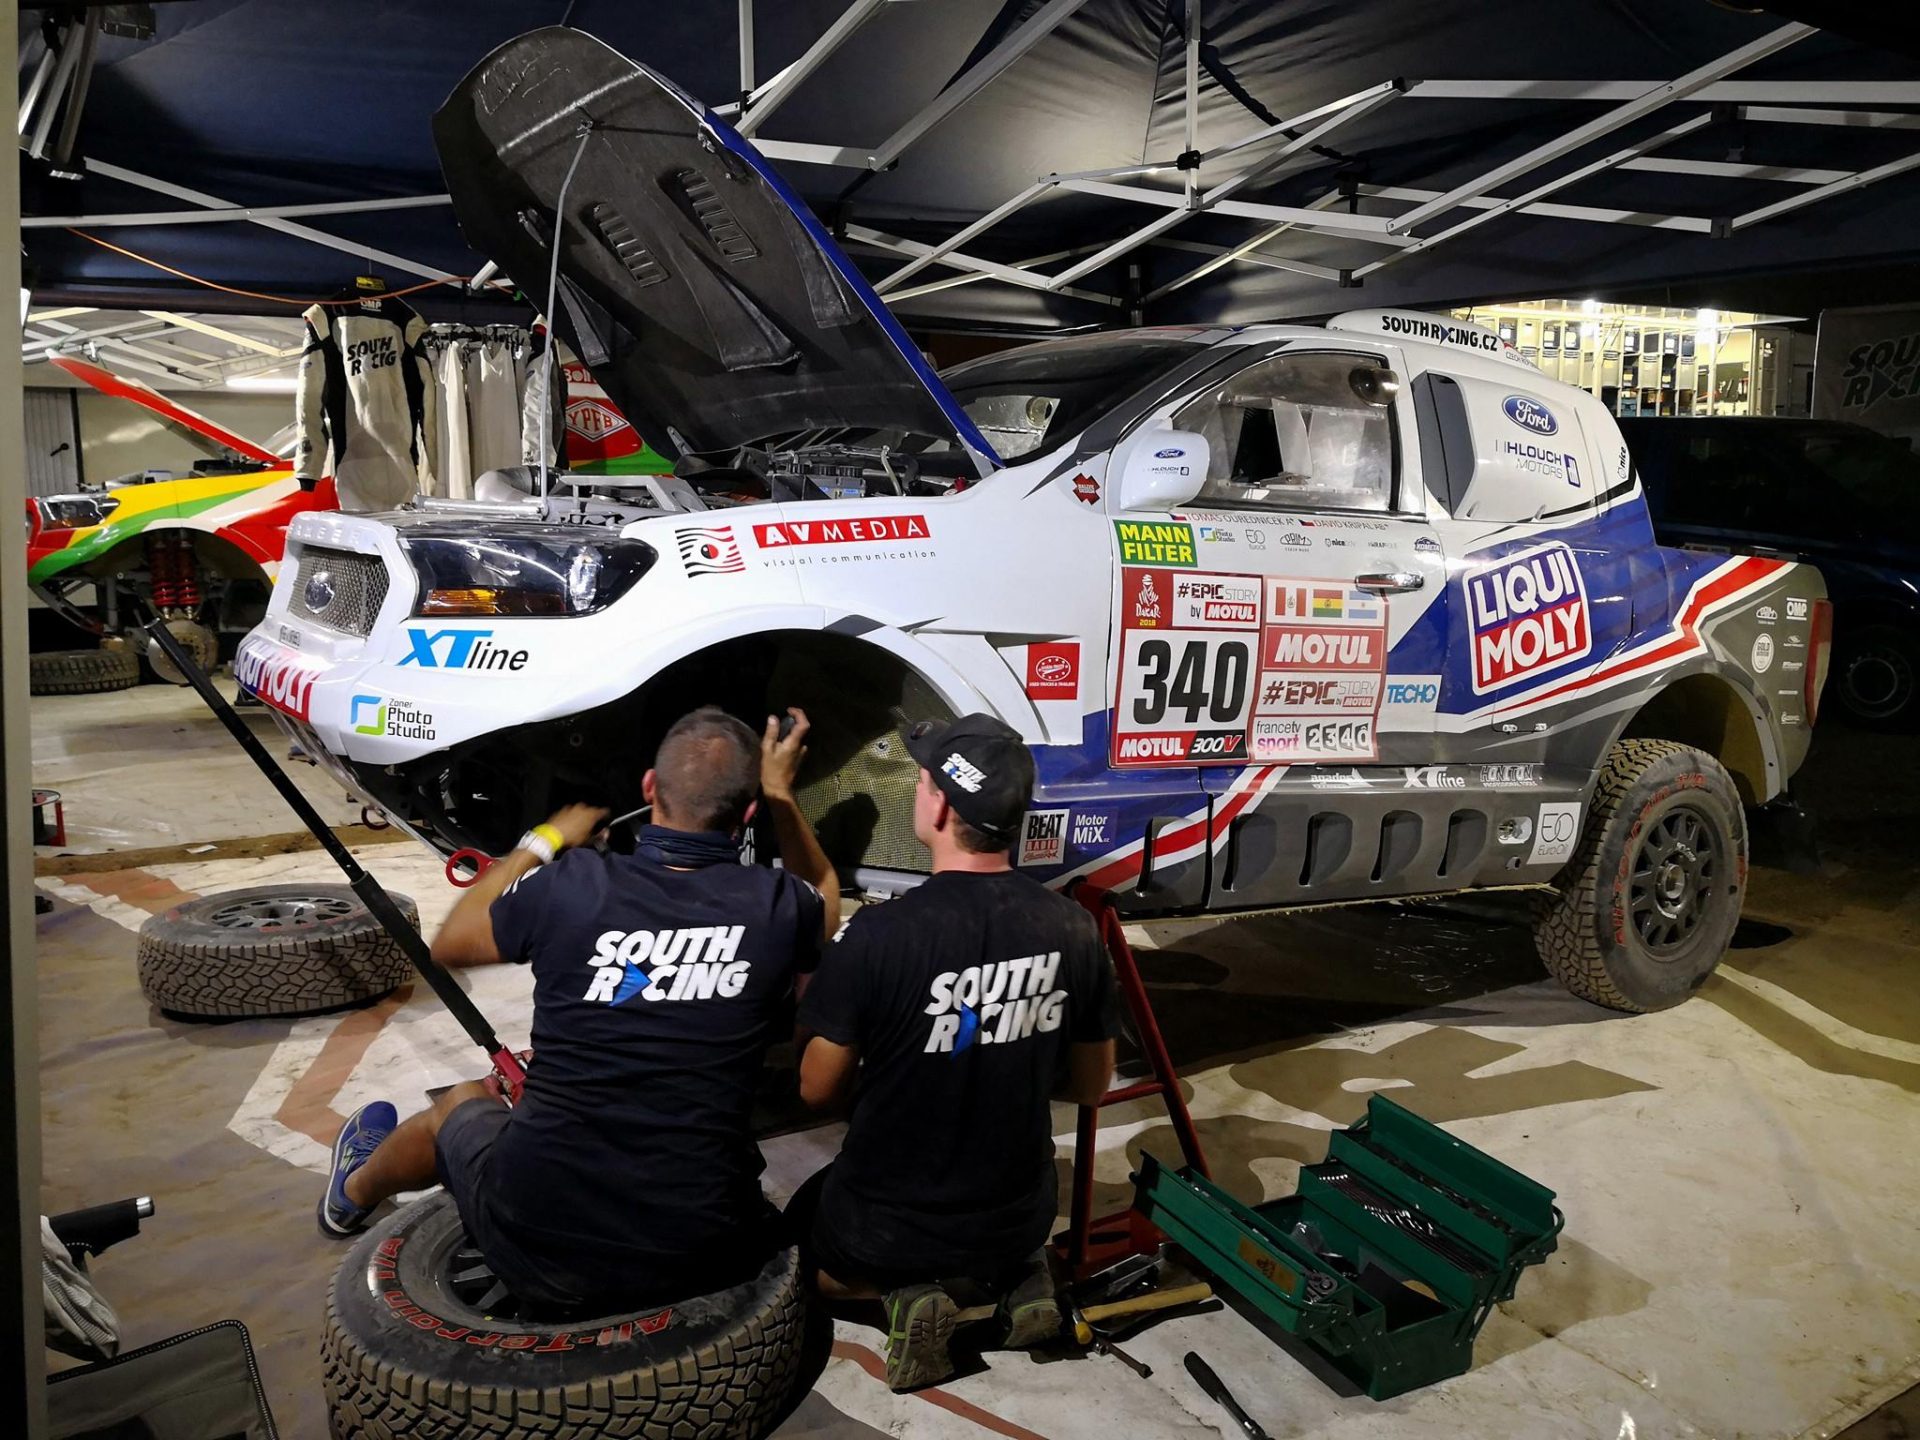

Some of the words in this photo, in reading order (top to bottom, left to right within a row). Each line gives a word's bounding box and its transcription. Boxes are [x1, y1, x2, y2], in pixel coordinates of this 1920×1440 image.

[568, 408, 613, 432] YPFB
[1515, 400, 1551, 431] Ford
[1507, 441, 1562, 465] HLOUCH
[1516, 458, 1563, 479] MOTORS
[765, 523, 811, 546] AV
[822, 517, 924, 541] MEDIA
[1120, 524, 1191, 543] MANN
[1314, 519, 1342, 528] DAVID
[763, 556, 813, 567] visual
[821, 550, 937, 564] communication
[1123, 543, 1193, 562] FILTER
[1473, 551, 1576, 627] LIQUI
[1191, 604, 1201, 618] by
[1206, 604, 1255, 620] MOTUL
[1786, 601, 1807, 617] OMP
[1274, 633, 1372, 664] MOTUL
[1480, 602, 1582, 682] MOLY
[260, 658, 318, 713] MOLY
[1133, 639, 1249, 724] 340
[389, 698, 412, 708] Zoner
[1343, 697, 1373, 707] MOTUL
[1387, 684, 1437, 703] TECHO
[388, 707, 432, 724] Photo
[388, 722, 435, 740] Studio
[1256, 721, 1301, 736] francetv
[1119, 738, 1184, 757] MOTUL
[1191, 735, 1242, 753] 300V
[1257, 736, 1300, 755] sport
[947, 753, 987, 784] SOUTH
[1027, 814, 1064, 839] BEAT
[1075, 814, 1108, 826] Motor
[1026, 839, 1058, 851] RADIO
[587, 925, 746, 967] SOUTH
[924, 951, 1061, 1016] SOUTH
